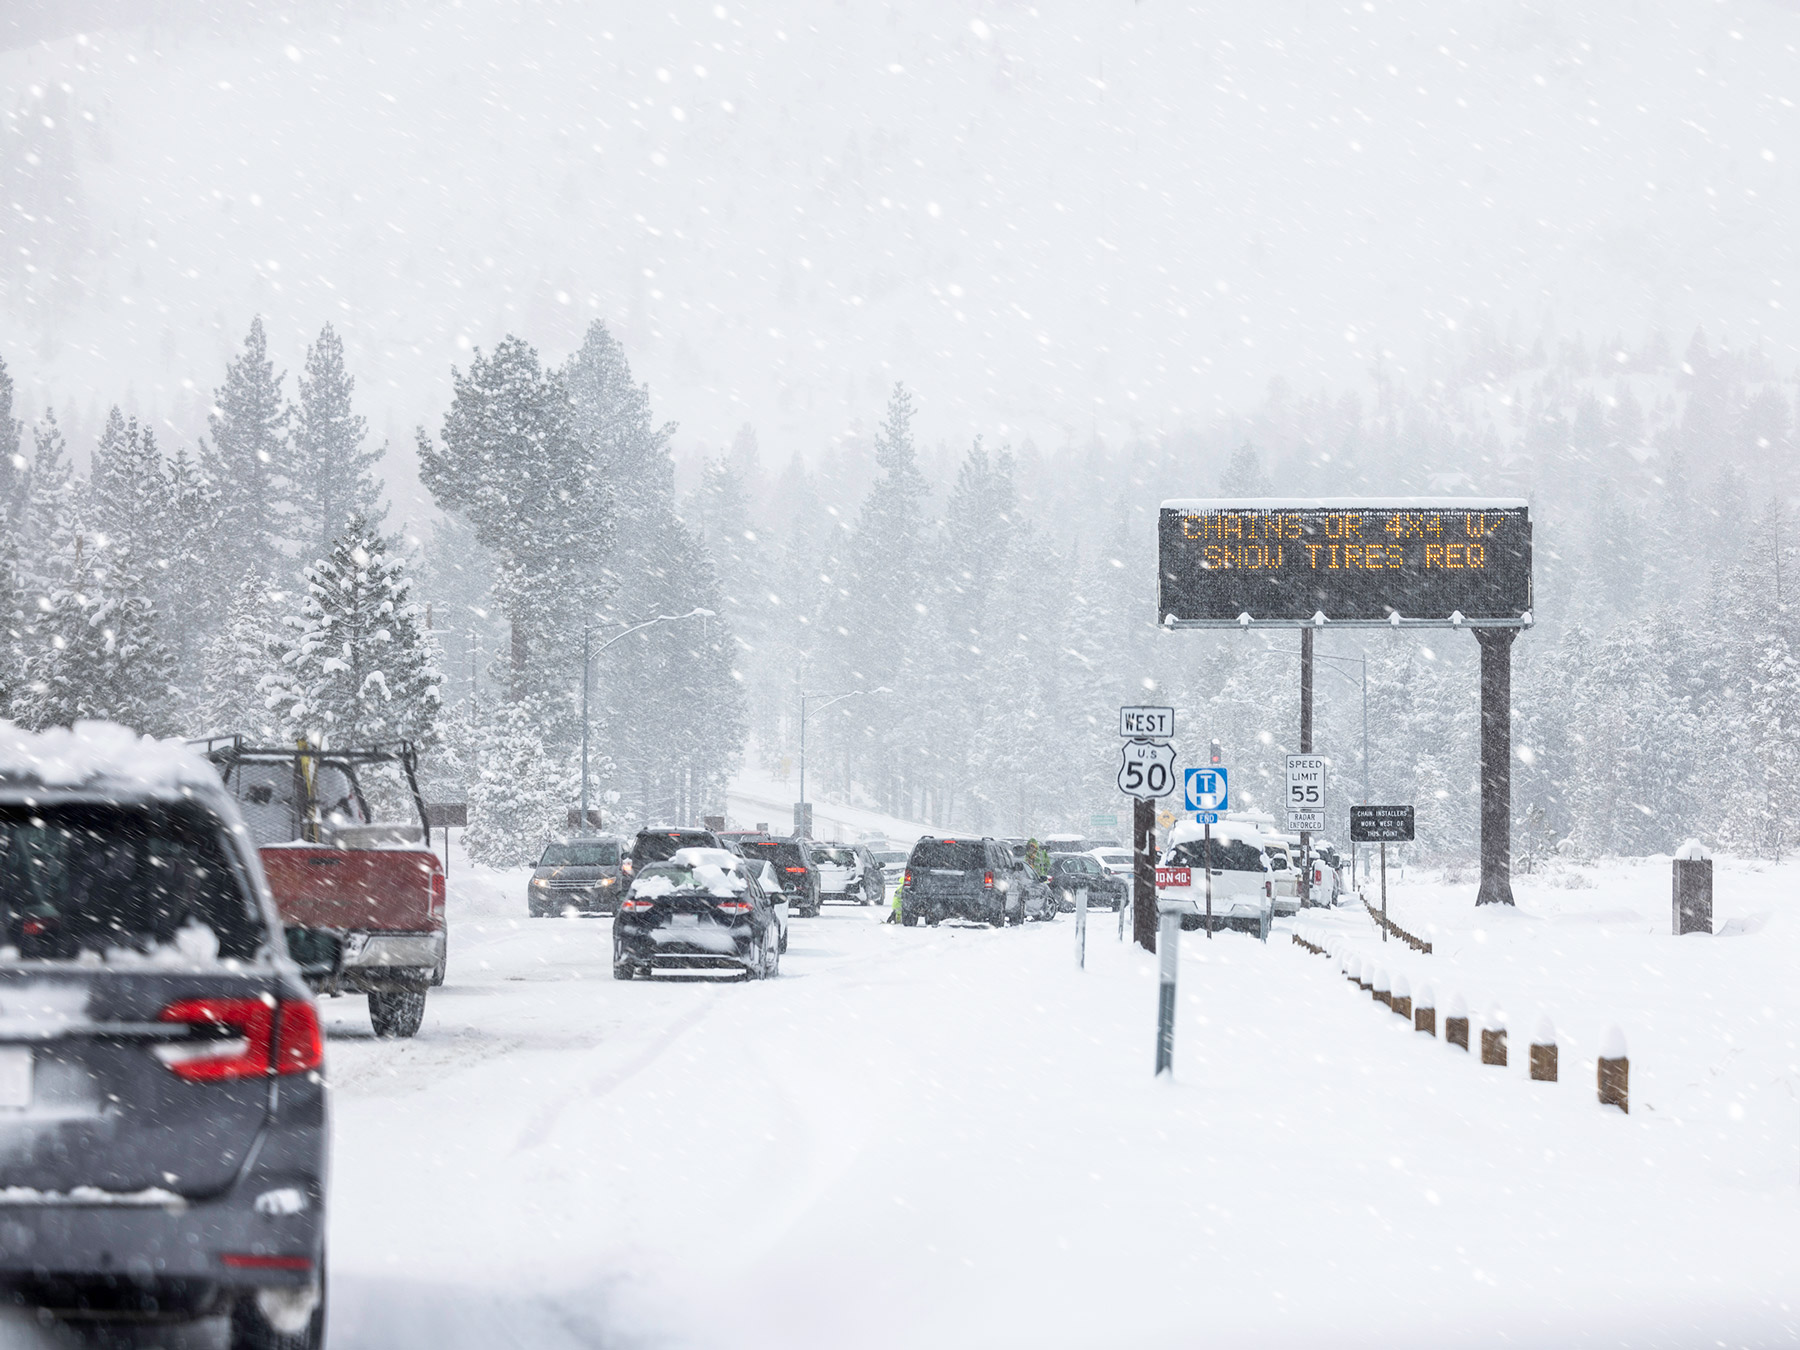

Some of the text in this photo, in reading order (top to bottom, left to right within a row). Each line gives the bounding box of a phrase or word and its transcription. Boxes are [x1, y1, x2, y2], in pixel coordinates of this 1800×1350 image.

[1183, 514, 1505, 539] CHAINS OR 4X4 W/
[1204, 544, 1484, 569] SNOW TIRES REQ
[1125, 712, 1166, 732] WEST
[1289, 760, 1322, 769] SPEED
[1125, 761, 1167, 791] 50
[1291, 773, 1318, 781] LIMIT
[1291, 785, 1320, 802] 55
[1199, 814, 1215, 823] END
[1294, 813, 1316, 821] RADAR
[1289, 821, 1322, 829] ENFORCED
